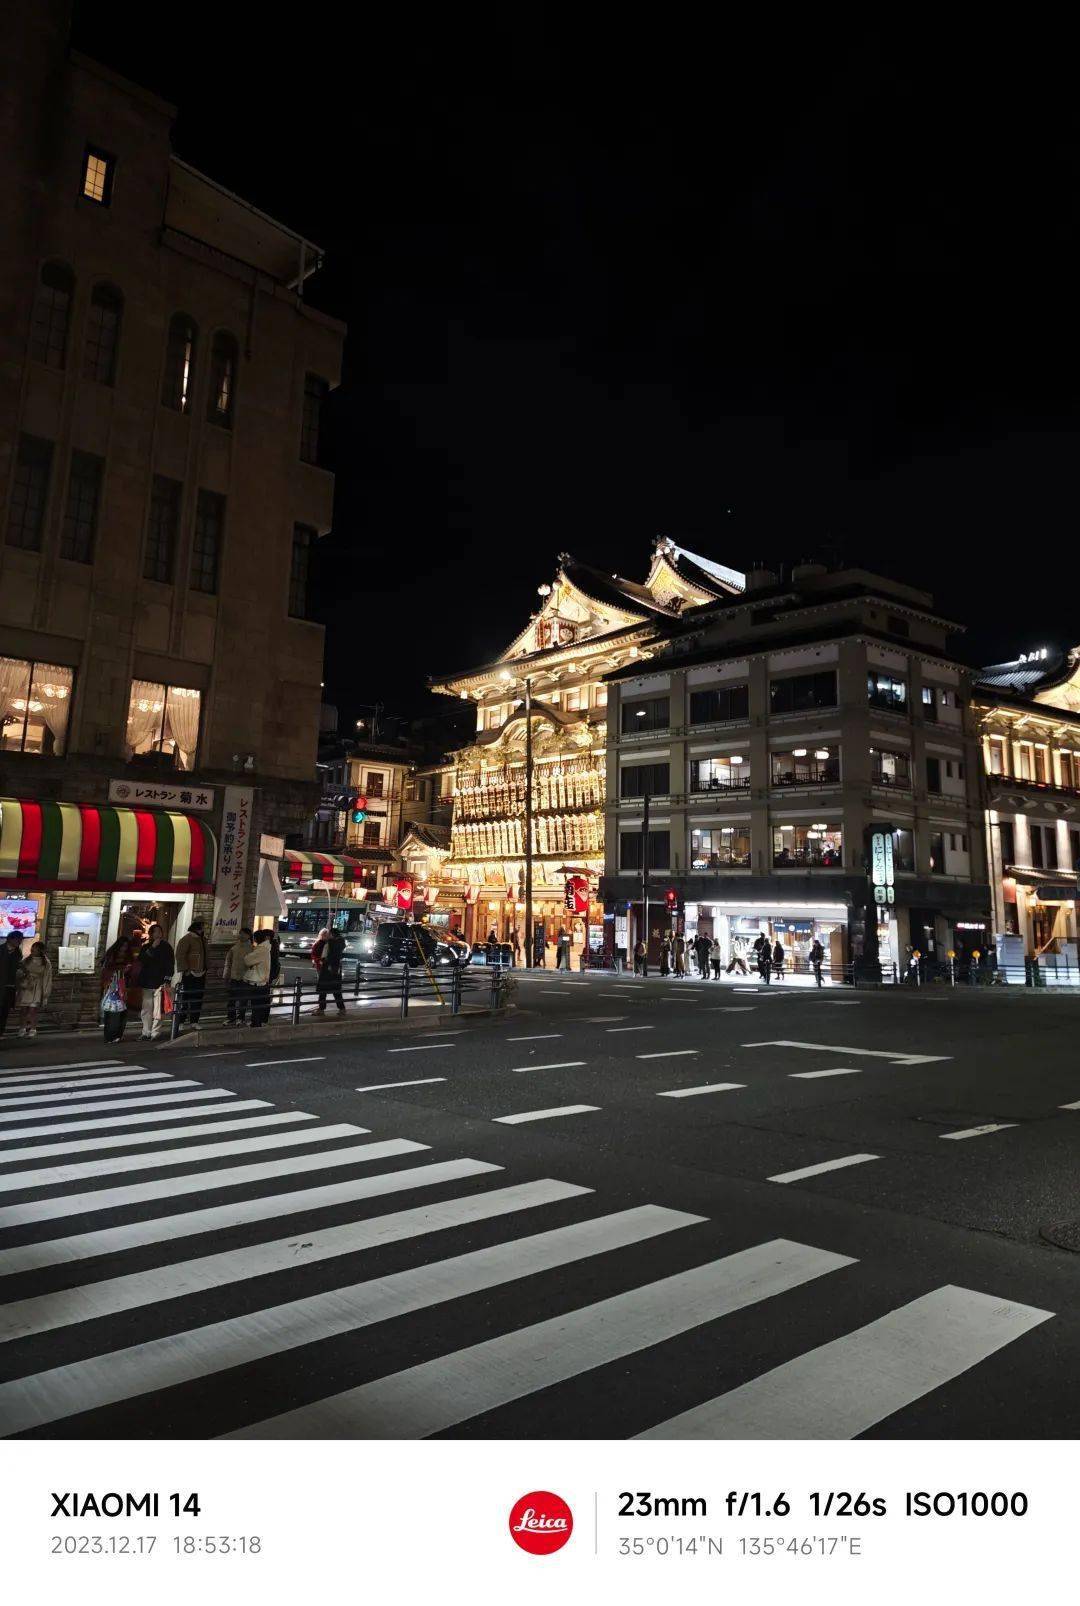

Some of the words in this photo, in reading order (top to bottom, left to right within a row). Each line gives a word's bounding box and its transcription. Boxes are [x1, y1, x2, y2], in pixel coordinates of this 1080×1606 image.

[136, 789, 176, 800] レストラン
[180, 791, 208, 804] 菊水
[230, 798, 248, 912] レストランウェディング
[216, 918, 237, 926] Asahi
